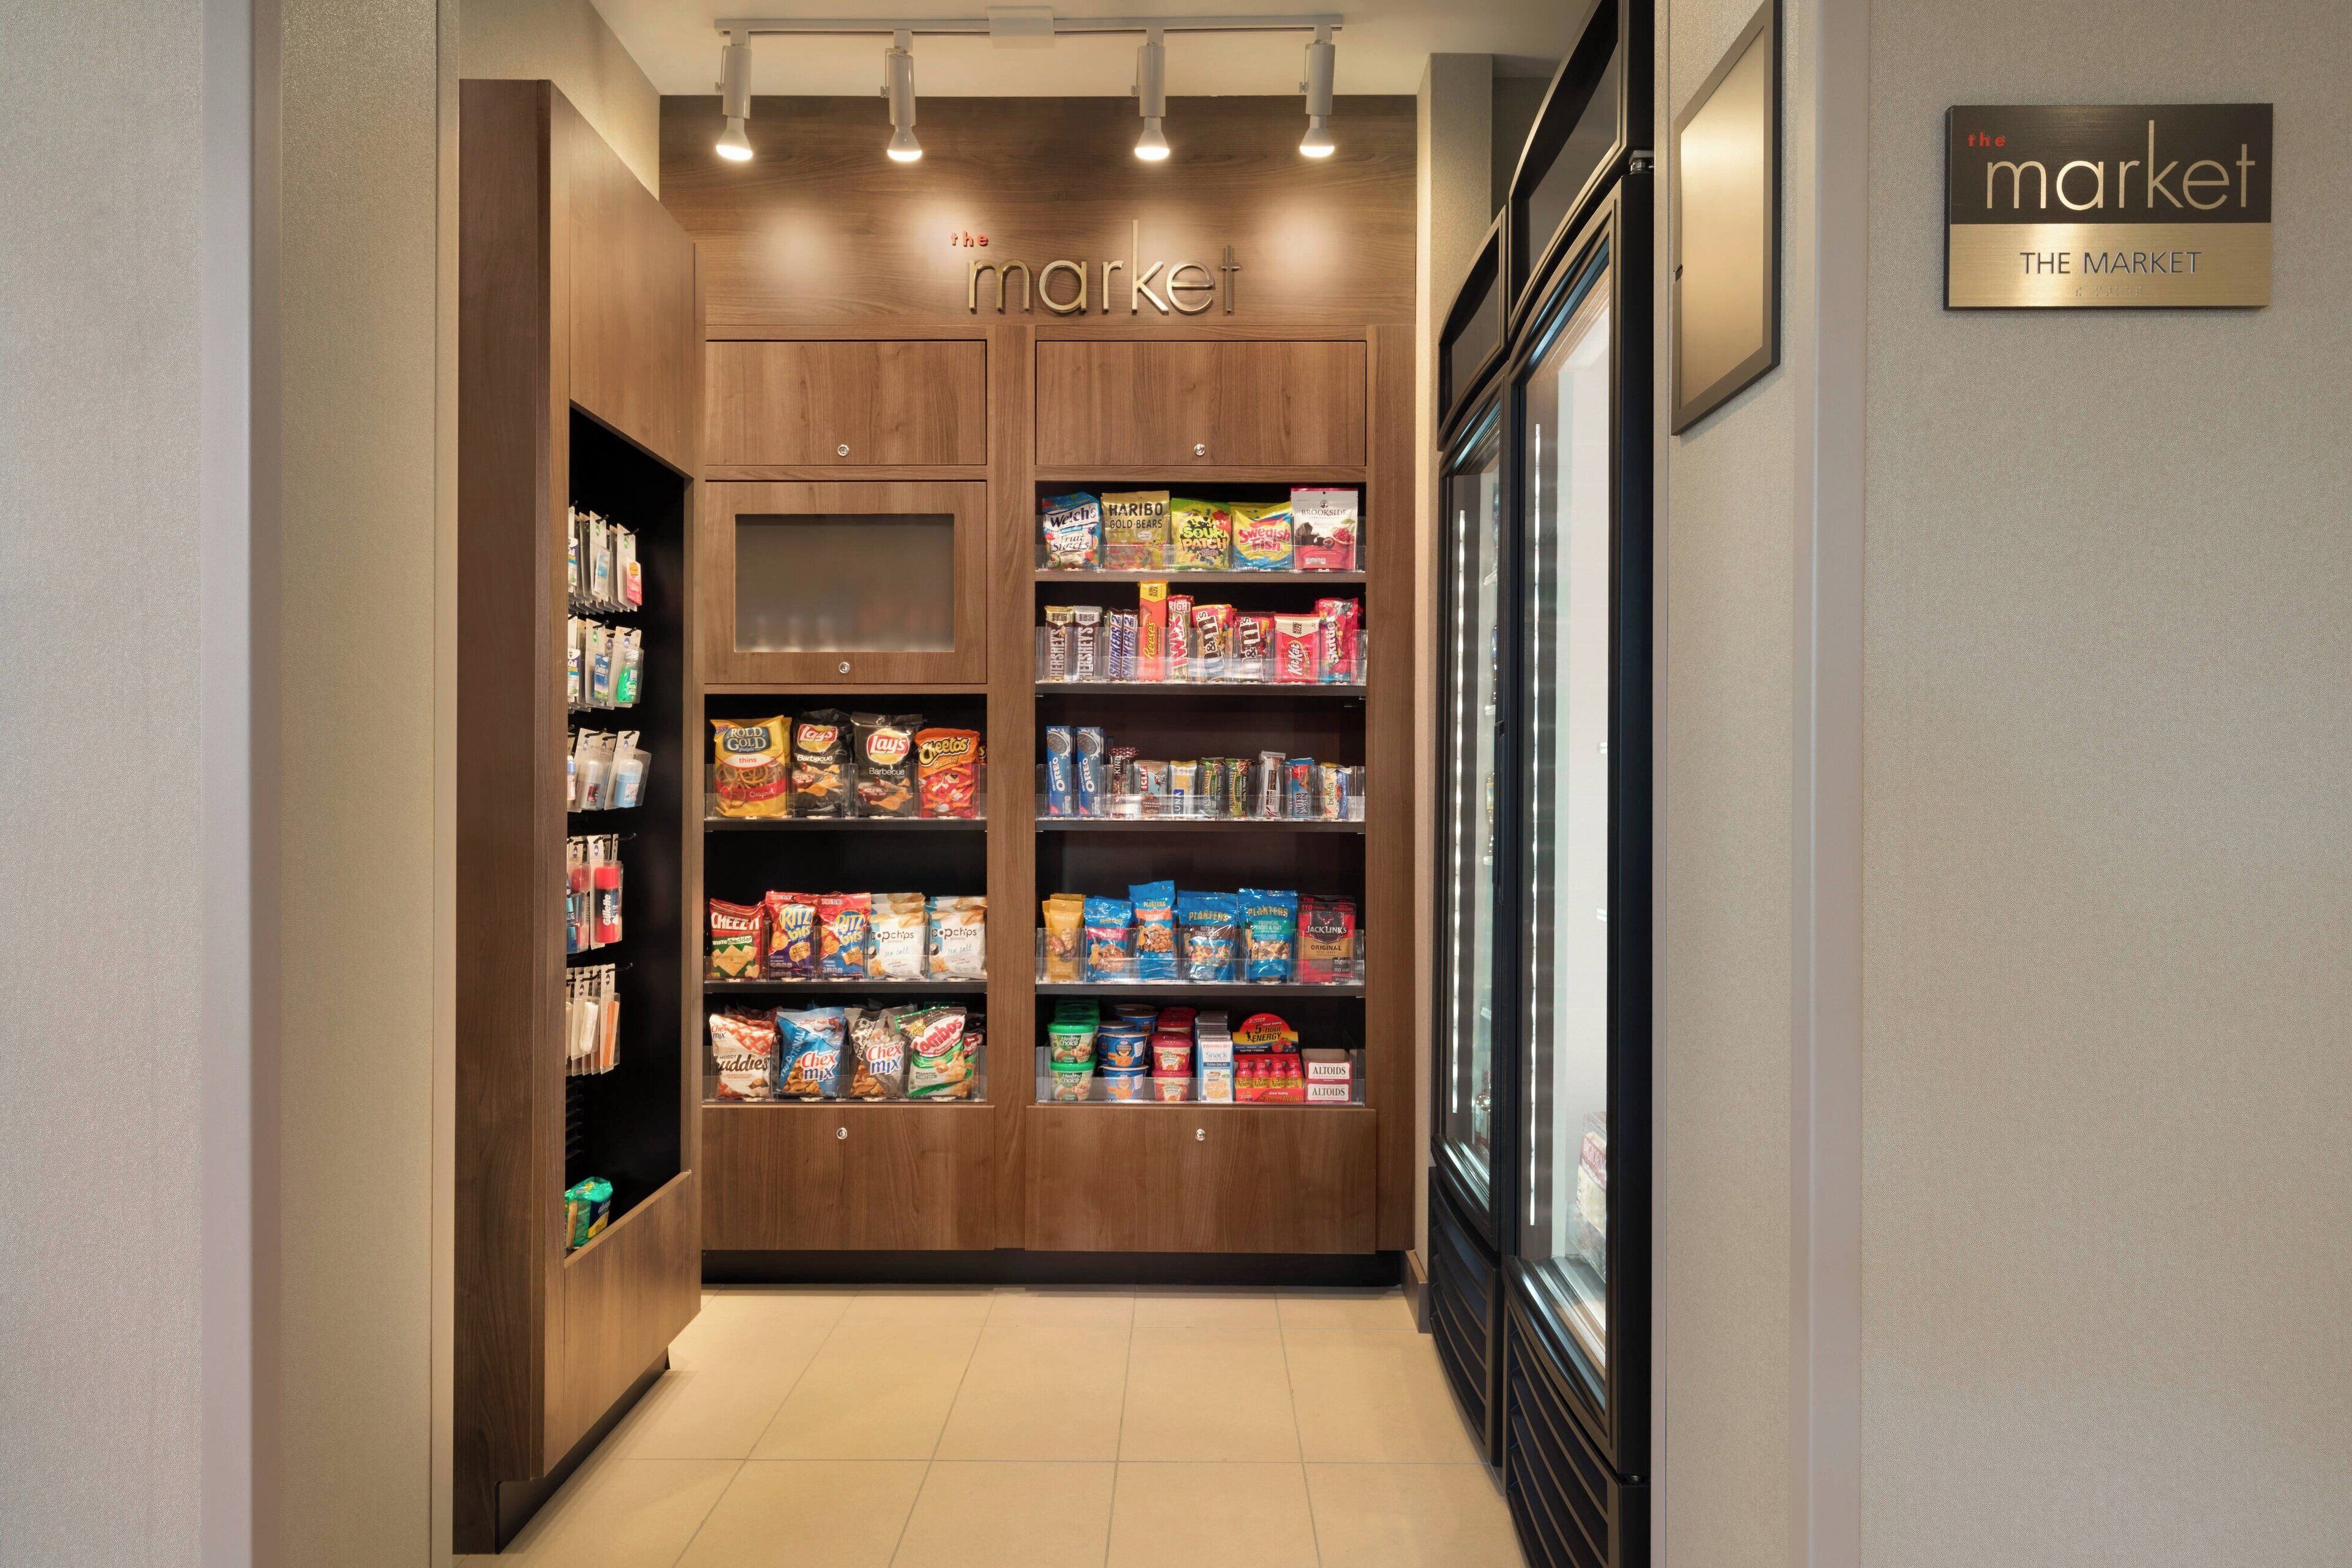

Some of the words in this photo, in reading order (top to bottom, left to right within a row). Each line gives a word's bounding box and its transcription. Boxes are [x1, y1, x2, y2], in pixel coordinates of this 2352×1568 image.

[1967, 132, 2006, 147] the
[1986, 119, 2256, 211] market
[951, 231, 989, 247] the
[968, 220, 1241, 315] market
[2020, 252, 2071, 274] THE
[2083, 251, 2202, 274] MARKET
[1050, 506, 1096, 527] Welch's
[1109, 502, 1163, 516] HARIBO
[1110, 519, 1163, 529] GOLD-BEARS
[1183, 526, 1224, 538] SOUR
[1238, 527, 1291, 543] Swedish
[1181, 537, 1227, 552] PATCH
[1251, 537, 1281, 553] Fish
[1168, 602, 1191, 612] RIGHT
[1168, 614, 1189, 668] TWIX
[1325, 615, 1340, 665] Skittles
[1050, 628, 1065, 678] HERSHEY'S
[1077, 626, 1094, 678] HERSHEY'S
[1109, 626, 1123, 677] SNICKERS
[1121, 627, 1136, 678] SNICKERS
[730, 726, 763, 738] ROLD
[727, 736, 767, 750] GOLD
[870, 735, 908, 754] Lay's
[919, 736, 968, 765] Cheetos
[1052, 757, 1065, 792] OREO
[1082, 757, 1095, 793] OREO
[749, 788, 775, 798] Original
[603, 894, 611, 926] Gillette
[1188, 910, 1227, 922] PLANTERS
[1246, 907, 1289, 918] PLANTERS
[710, 911, 761, 930] CHEEZ-IT
[780, 907, 814, 930] RITZ
[835, 913, 865, 935] RITZ
[1305, 924, 1325, 934] JACK
[727, 935, 752, 944] cheddar
[711, 1024, 727, 1033] Chex
[1251, 1031, 1282, 1042] ENERGY
[1254, 1023, 1283, 1035] 5-hour
[867, 1042, 903, 1061] Chex
[715, 1054, 771, 1072] uddies
[801, 1052, 839, 1068] Chex
[871, 1055, 902, 1074] mix
[804, 1065, 835, 1080] mix
[1313, 1066, 1346, 1075] ALTOIDS
[1312, 1087, 1346, 1096] ALTOIDS
